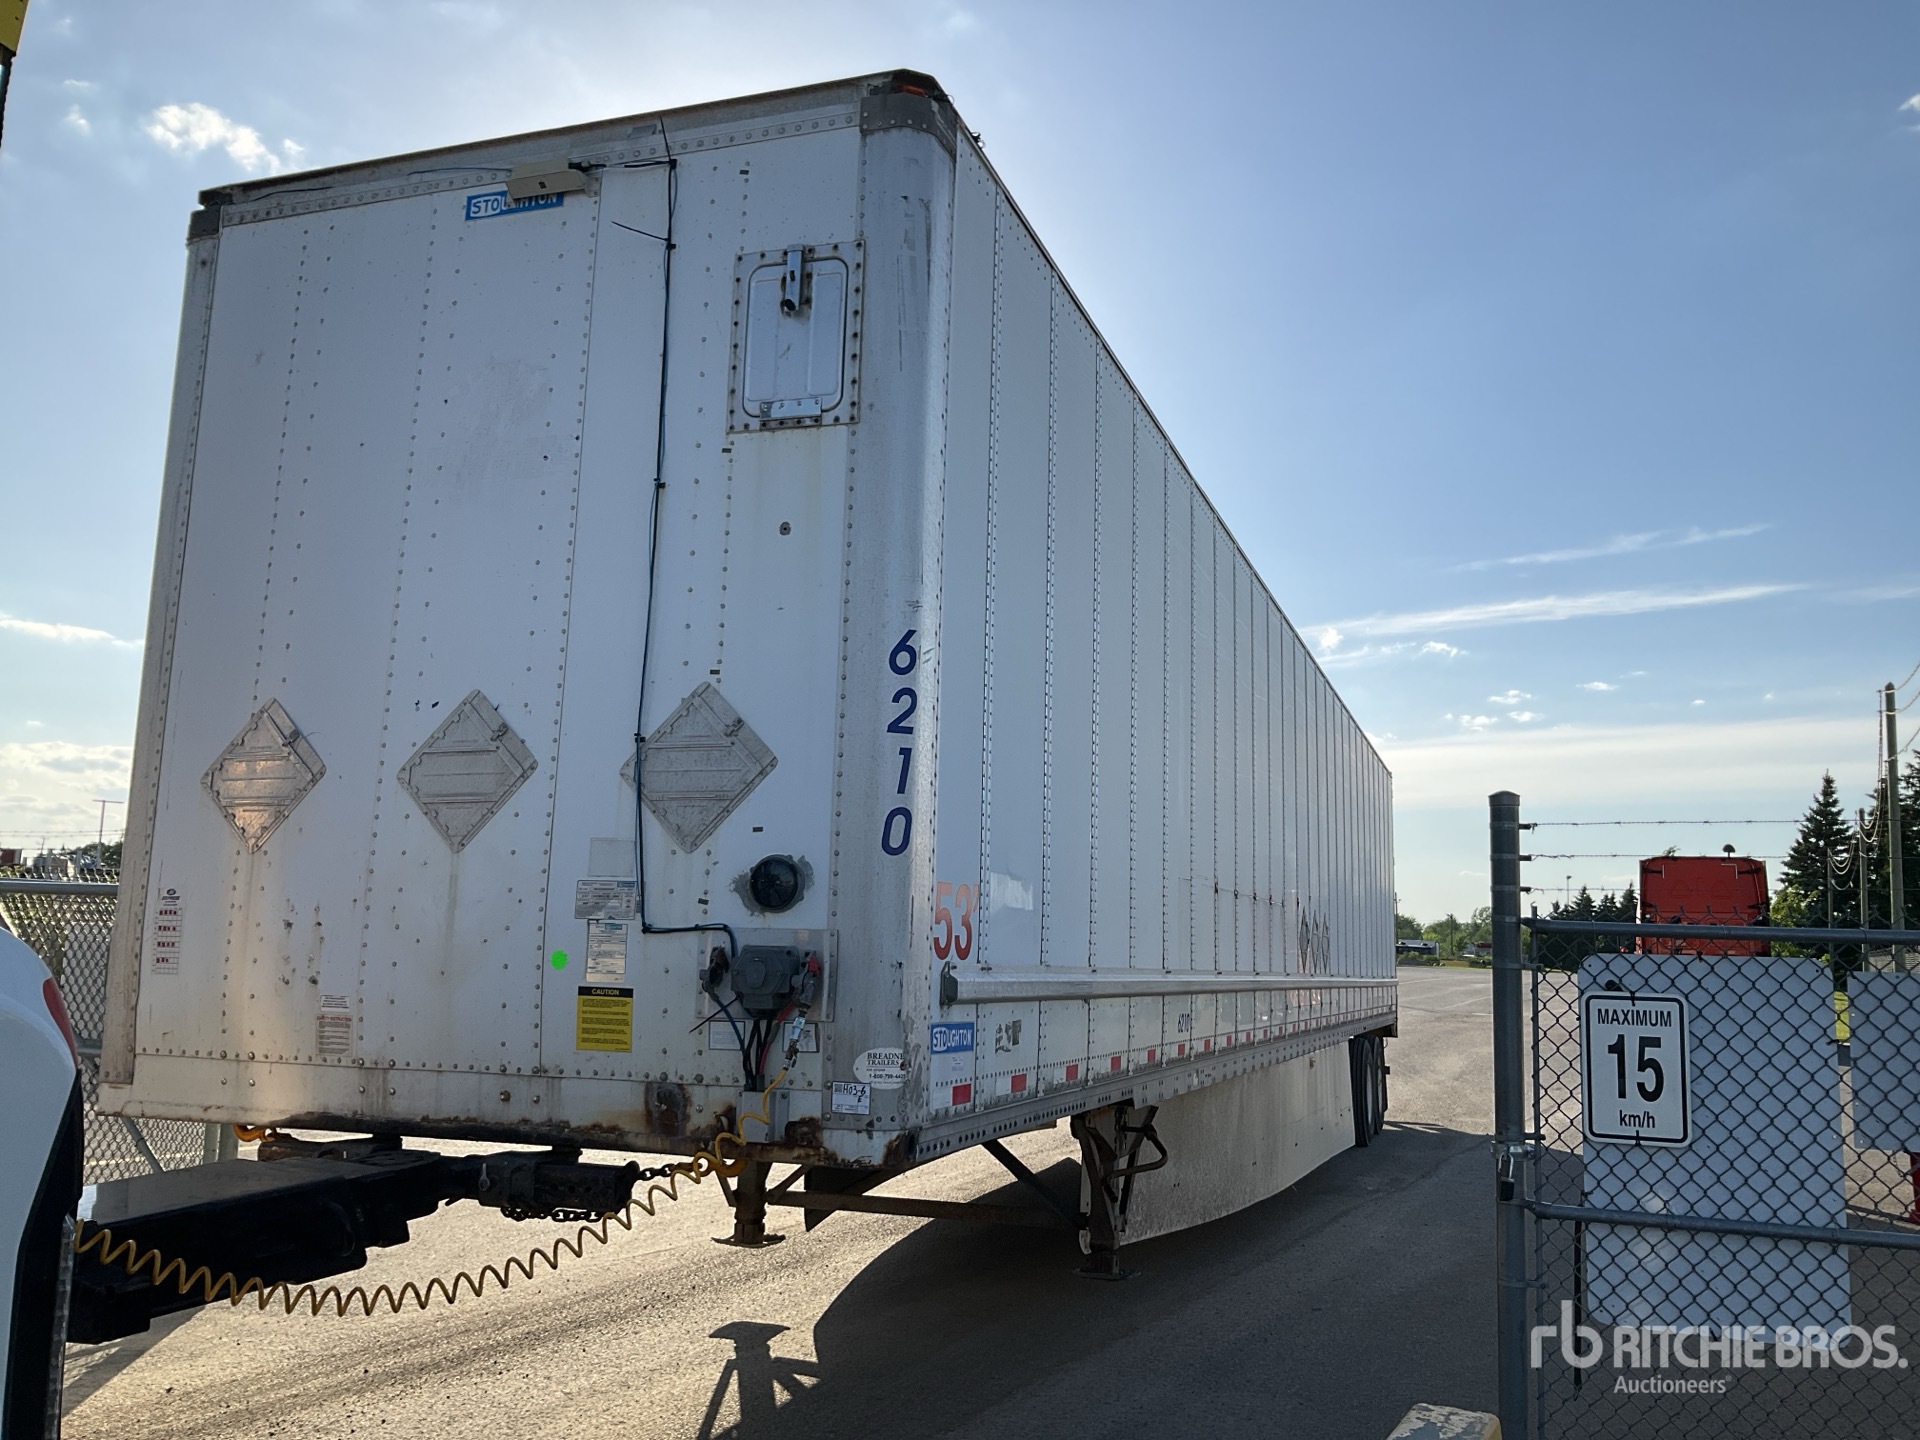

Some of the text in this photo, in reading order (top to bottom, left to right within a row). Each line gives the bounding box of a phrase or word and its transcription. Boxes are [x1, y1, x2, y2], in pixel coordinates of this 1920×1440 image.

[881, 629, 918, 856] 6210
[1597, 1008, 1672, 1027] MAXIMUM
[932, 1028, 973, 1051] STOUGHTON
[1607, 1033, 1664, 1102] 15
[1619, 1109, 1656, 1129] km/h
